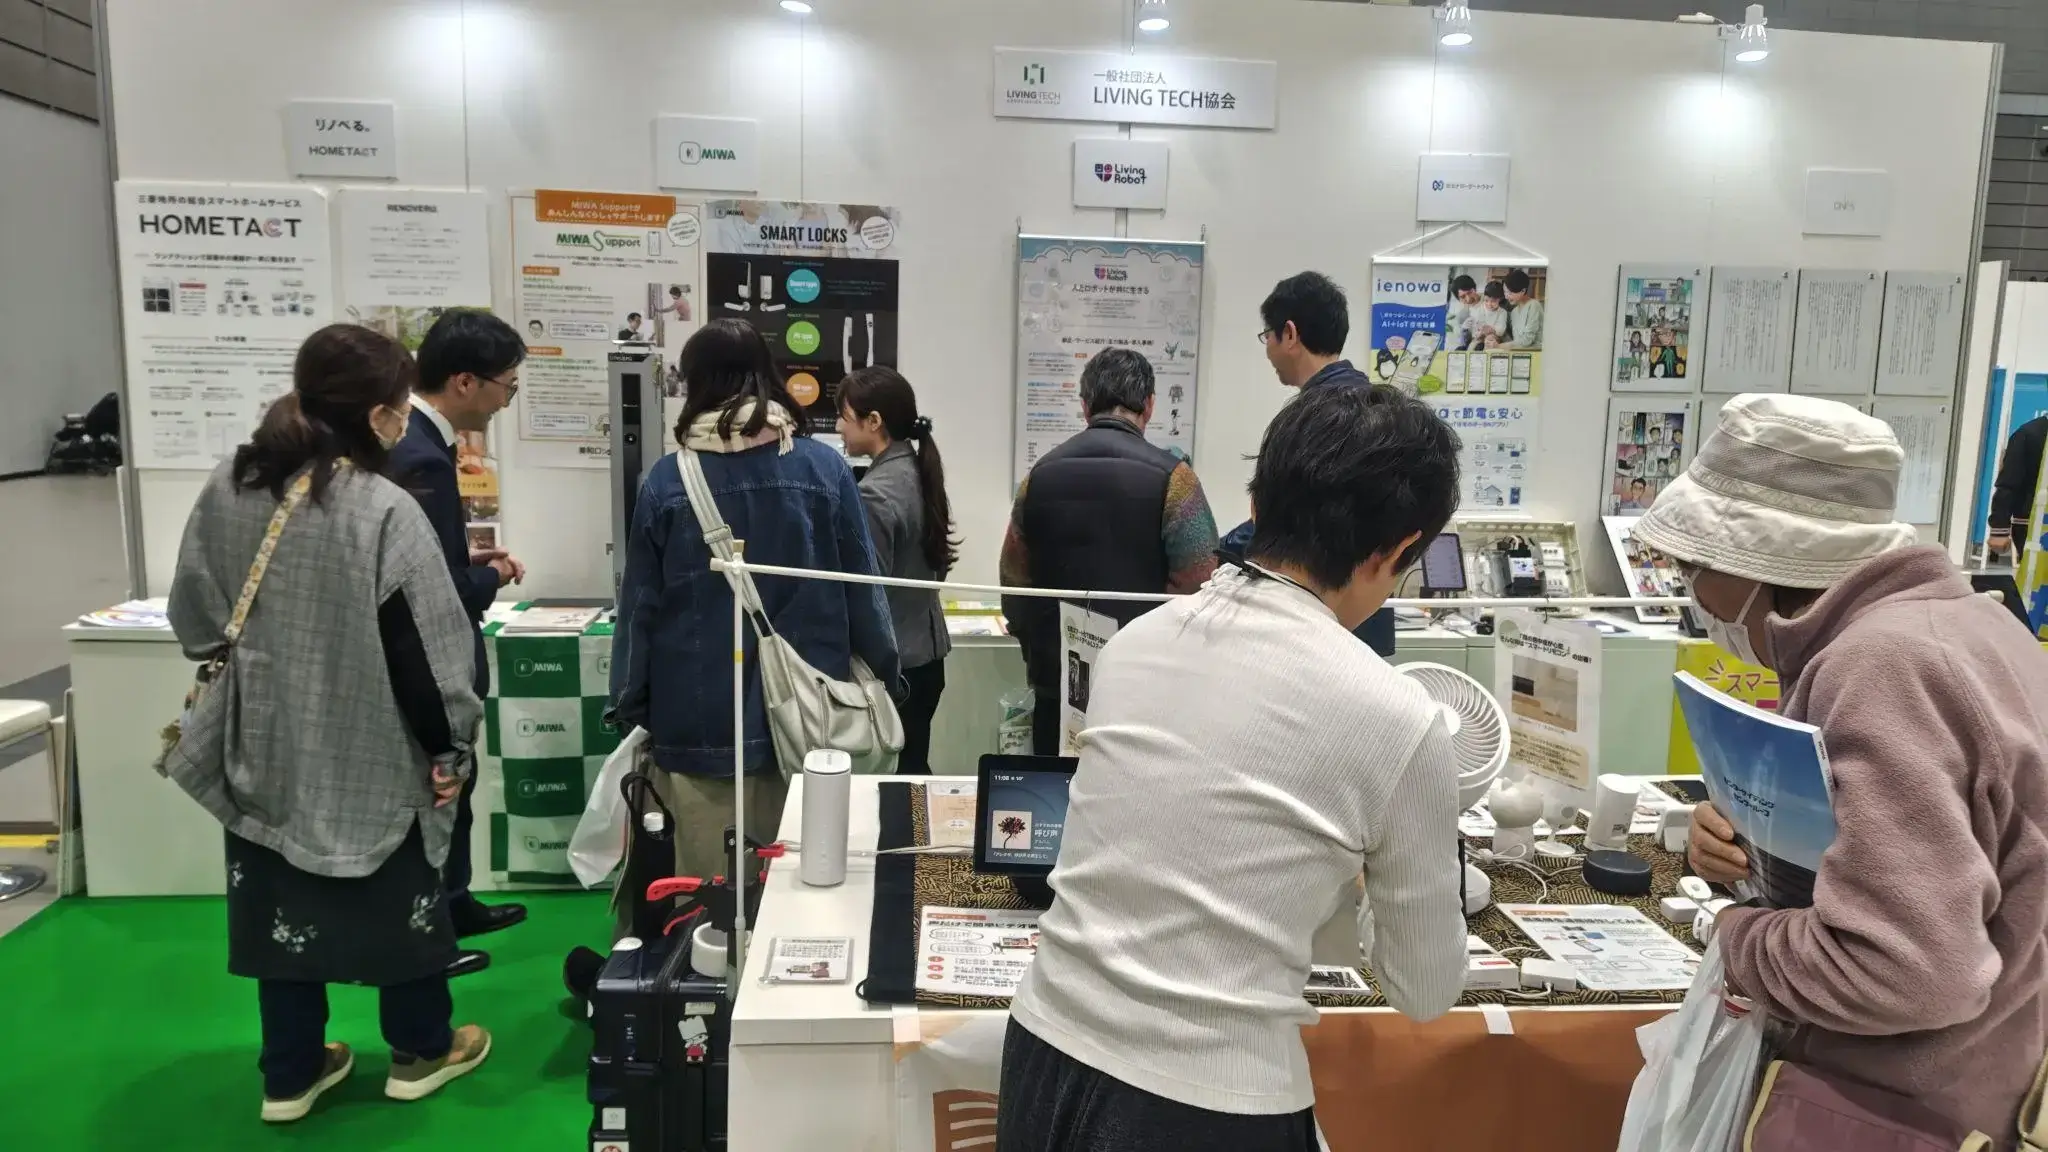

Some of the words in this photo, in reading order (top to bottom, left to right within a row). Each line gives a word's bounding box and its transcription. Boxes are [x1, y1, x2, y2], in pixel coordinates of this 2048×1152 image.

[1093, 69, 1166, 85] 一般社団法人
[1006, 90, 1037, 99] LIVING
[1038, 91, 1061, 100] TECH
[1093, 87, 1153, 106] LIVING
[1158, 89, 1236, 110] TECH協会
[308, 146, 378, 157] HOMETACT
[701, 148, 736, 160] MIWA
[1114, 164, 1146, 176] Living
[1114, 174, 1147, 185] Robot
[571, 201, 597, 210] MIWA
[139, 214, 302, 238] HOMETACT
[760, 225, 804, 242] SMART
[807, 227, 848, 243] LOCKS
[556, 233, 590, 245] MIWA
[593, 230, 641, 252] Support
[1377, 278, 1441, 293] ienowa
[534, 663, 563, 673] MIWA
[536, 723, 566, 733] MIWA
[537, 783, 567, 793] MIWA
